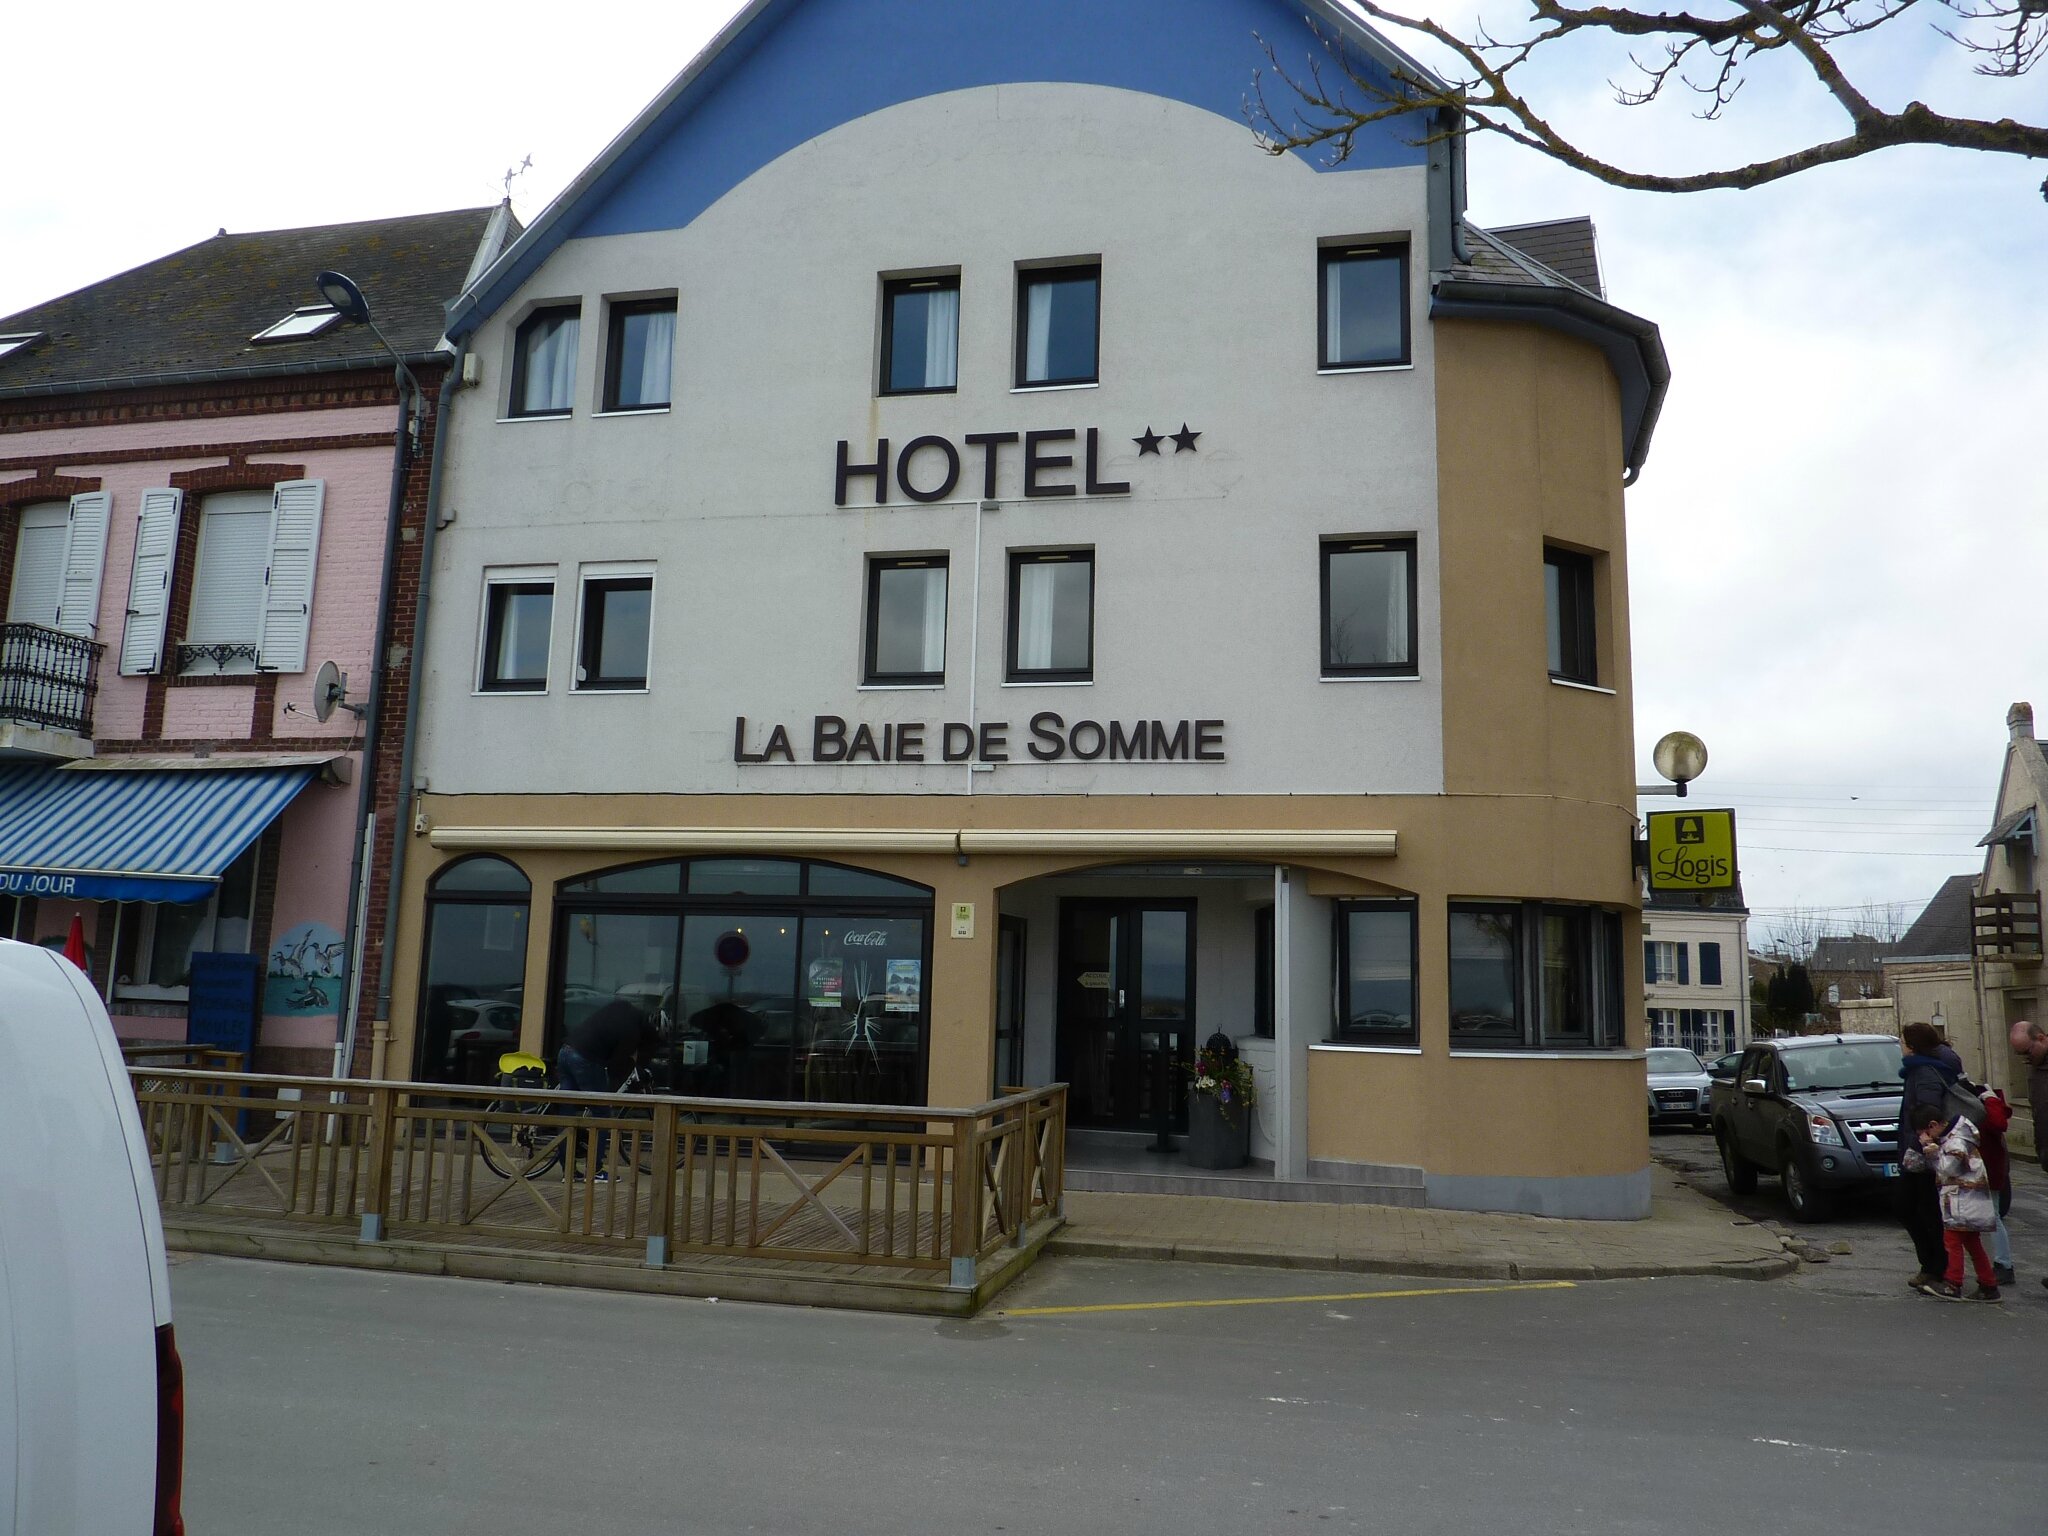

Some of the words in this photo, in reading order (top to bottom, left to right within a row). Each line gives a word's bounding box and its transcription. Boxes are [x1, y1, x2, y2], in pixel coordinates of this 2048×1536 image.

[834, 427, 1131, 506] HOTEL
[734, 716, 796, 763] LA
[812, 714, 926, 763] BAIE
[942, 721, 1010, 762] DE
[1026, 710, 1225, 761] SOMME
[0, 873, 23, 891] DU
[25, 874, 76, 894] JOUR
[1655, 845, 1729, 885] Logis
[843, 930, 888, 946] Coca-Cola
